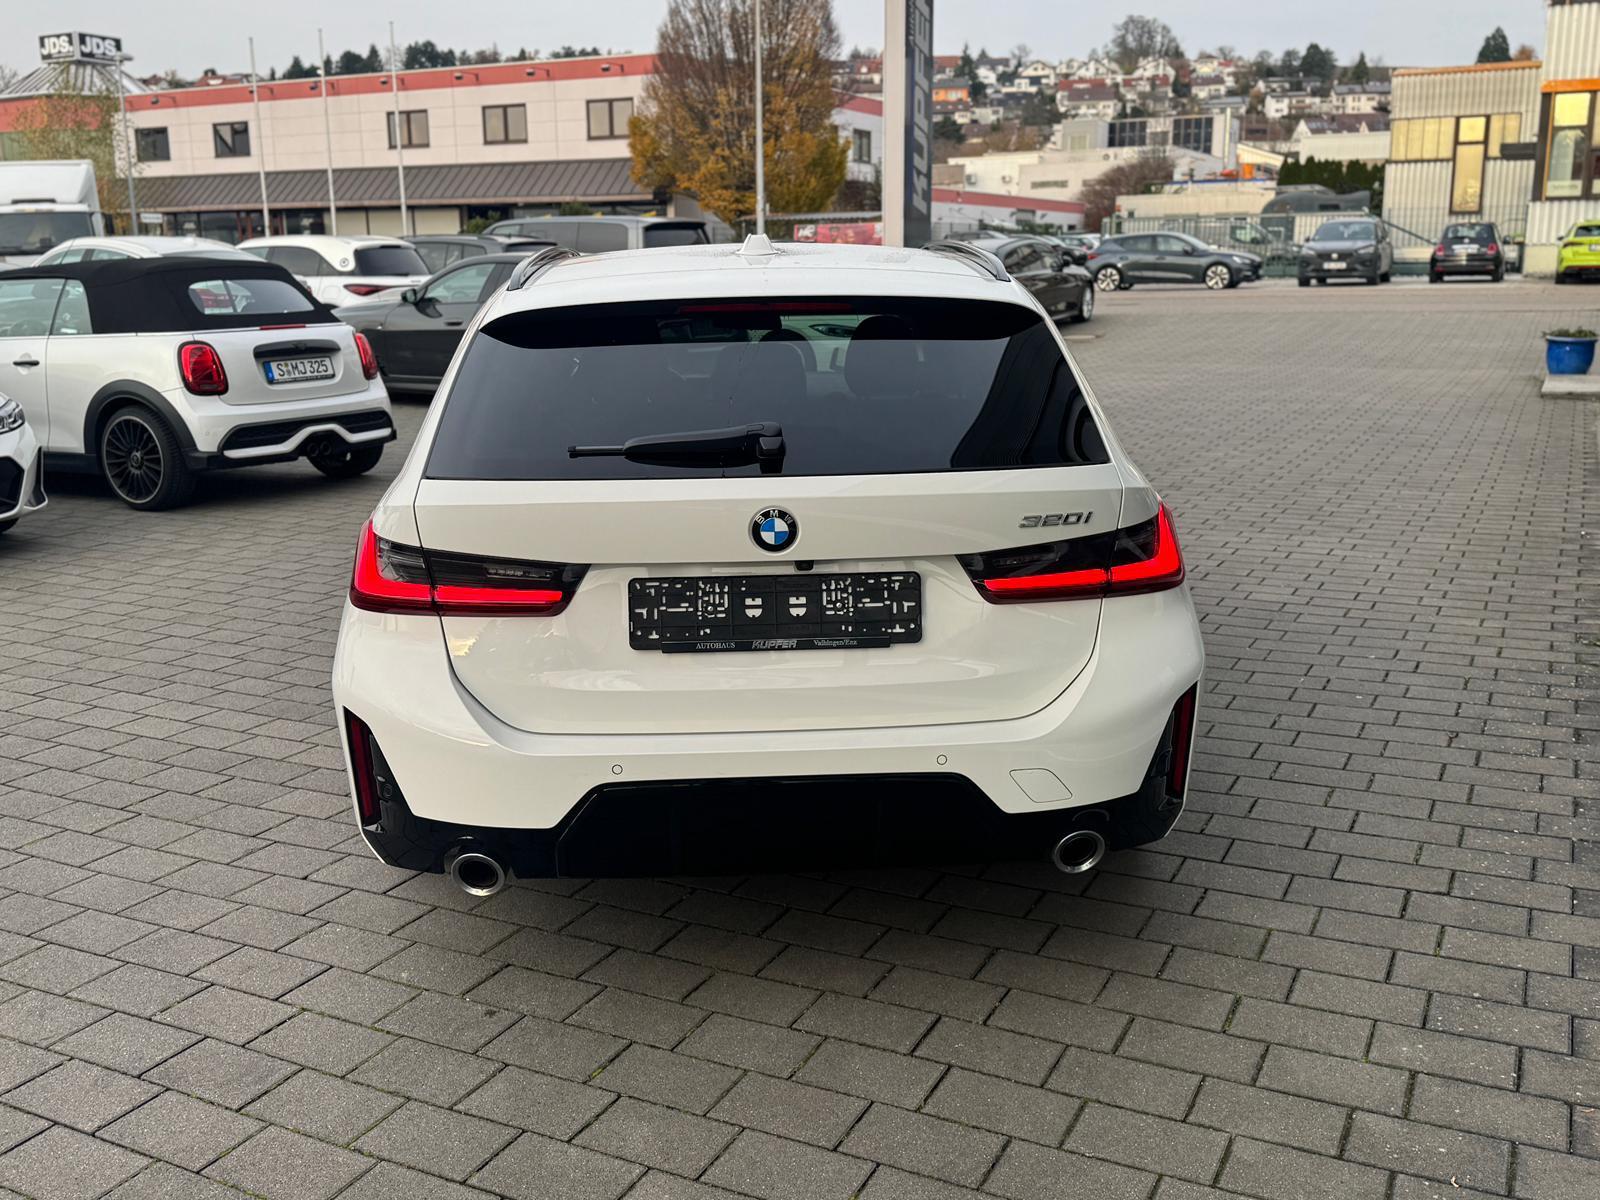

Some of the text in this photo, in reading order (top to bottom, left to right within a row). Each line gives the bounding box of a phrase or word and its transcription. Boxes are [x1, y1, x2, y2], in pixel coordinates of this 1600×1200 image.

[276, 363, 286, 377] S
[308, 360, 329, 374] 325
[755, 509, 794, 525] BMW
[1019, 510, 1093, 529] 320i
[695, 641, 736, 650] AUTOHAUS
[751, 640, 797, 649] KUPFER
